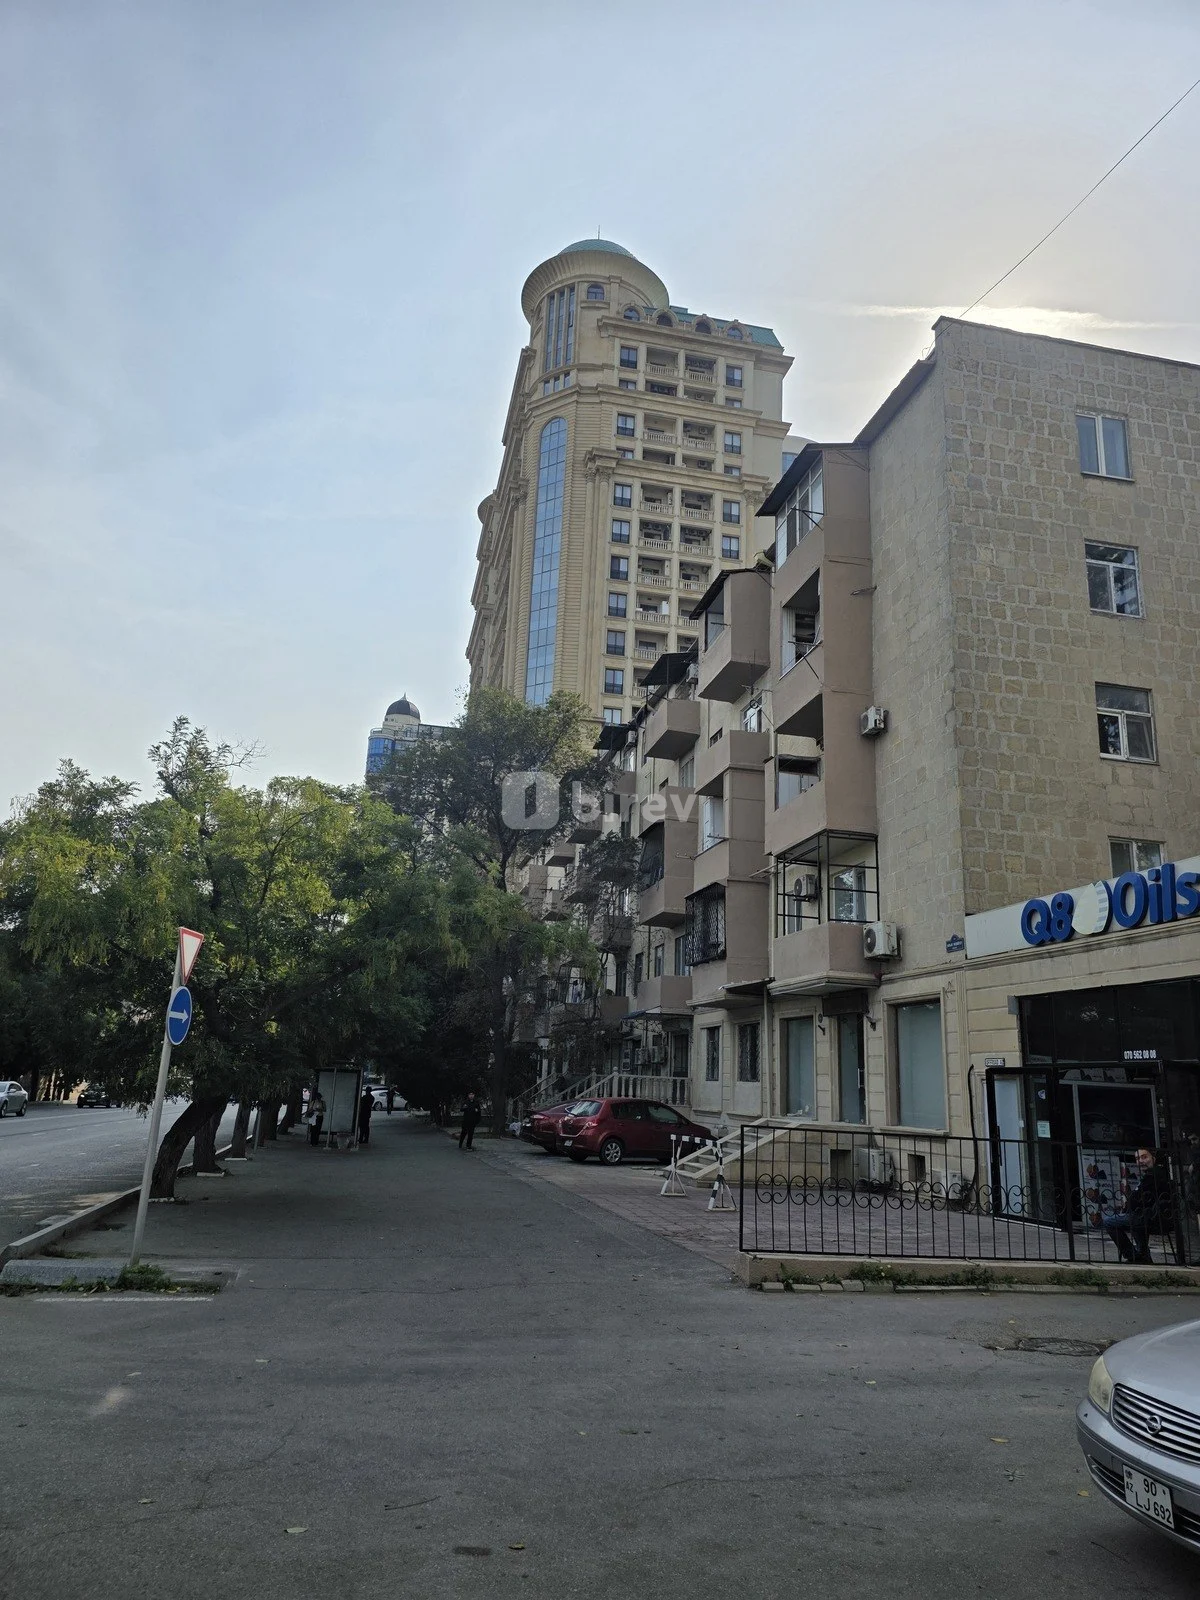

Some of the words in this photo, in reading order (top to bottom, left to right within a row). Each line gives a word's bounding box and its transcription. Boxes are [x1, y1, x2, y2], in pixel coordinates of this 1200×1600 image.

[1021, 893, 1075, 945] Q8
[1112, 862, 1200, 928] Oils
[1125, 1481, 1134, 1493] AZ
[1143, 1478, 1157, 1496] 90
[1153, 1501, 1173, 1525] 692
